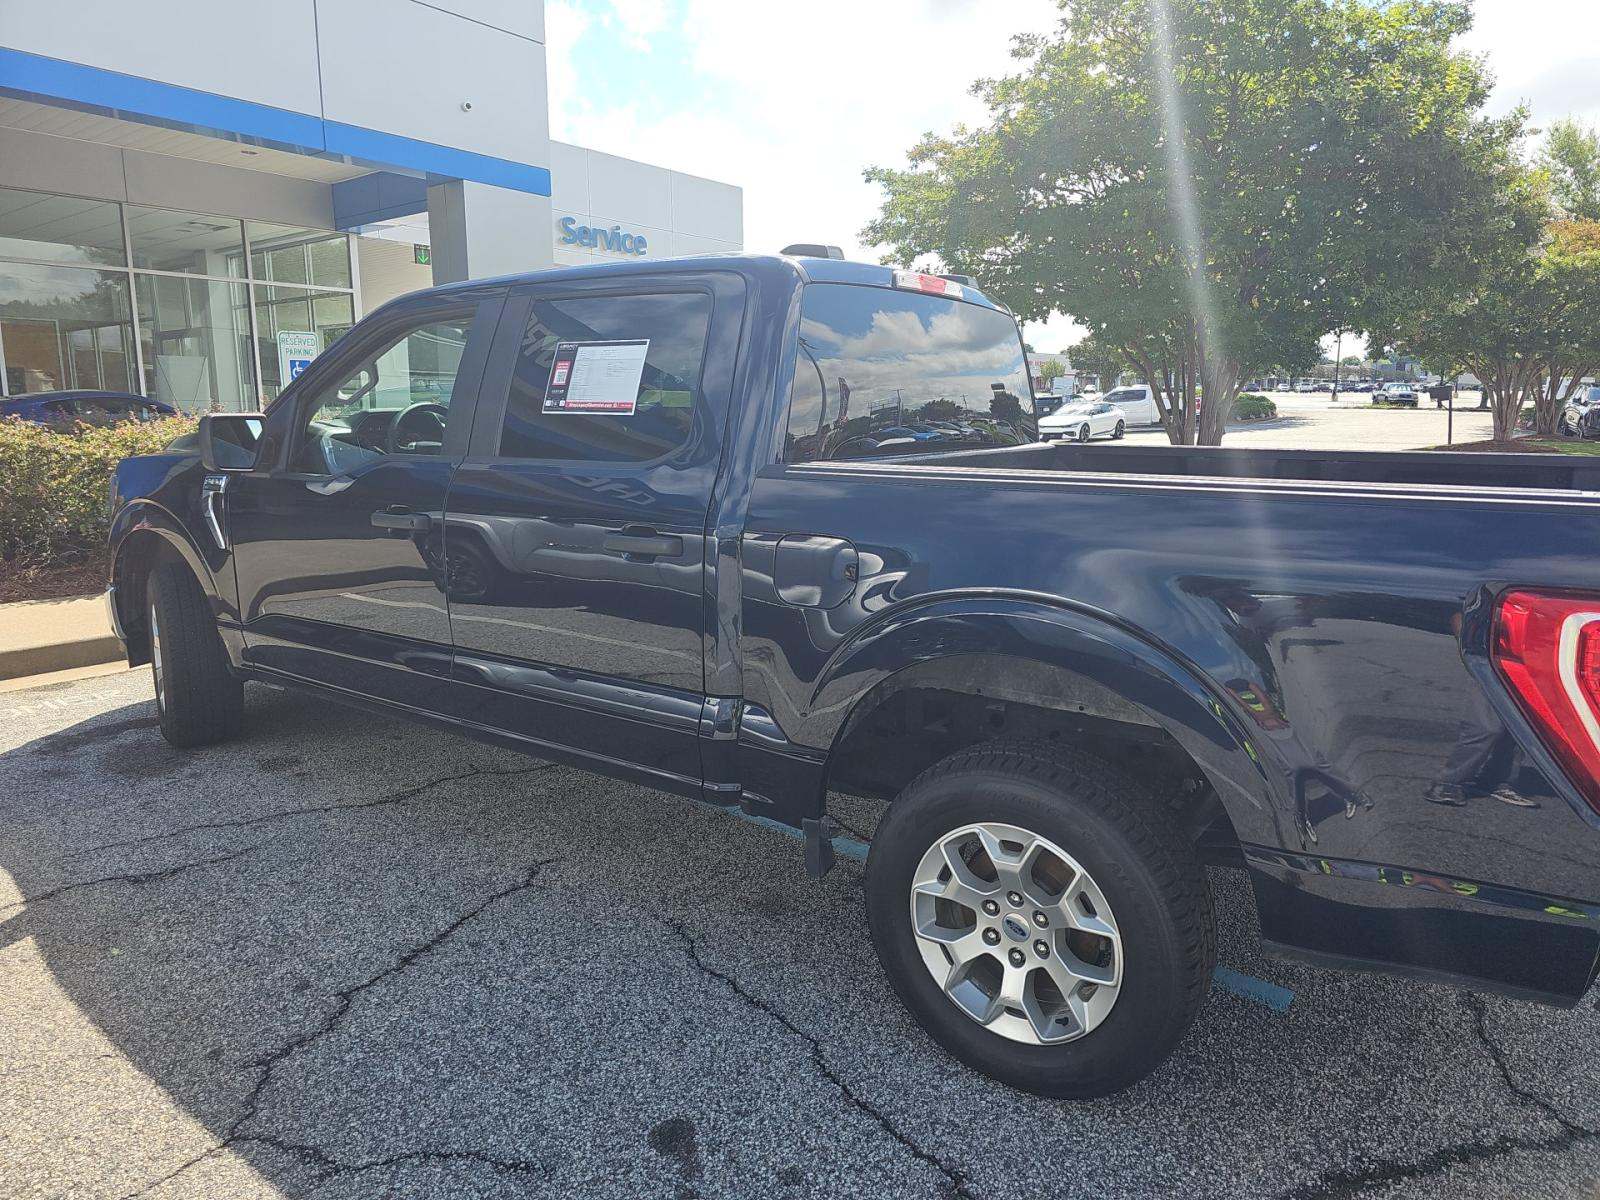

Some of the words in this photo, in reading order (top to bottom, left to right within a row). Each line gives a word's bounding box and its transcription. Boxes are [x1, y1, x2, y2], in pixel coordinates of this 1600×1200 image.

[560, 216, 648, 255] Service
[280, 337, 316, 346] RESERVED
[286, 347, 314, 356] PARKING
